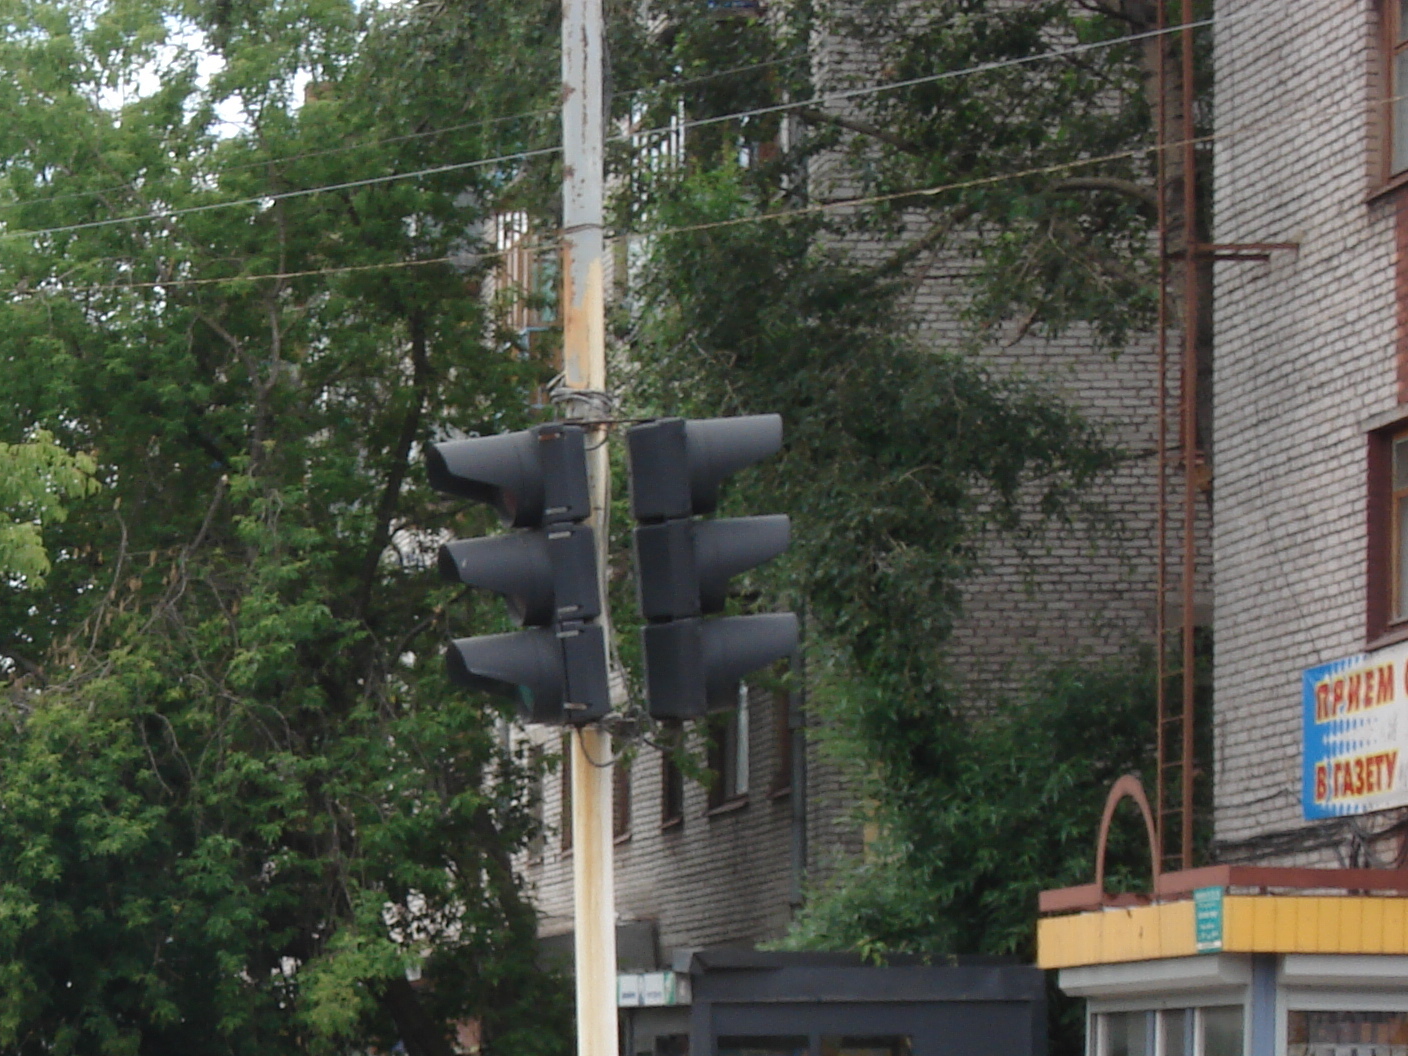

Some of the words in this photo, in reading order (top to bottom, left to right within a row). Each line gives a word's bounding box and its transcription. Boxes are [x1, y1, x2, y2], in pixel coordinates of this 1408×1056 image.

[1315, 662, 1395, 724] ПРИЕМ
[1315, 762, 1328, 804] В
[1332, 749, 1399, 801] ГАЗЕТУ
